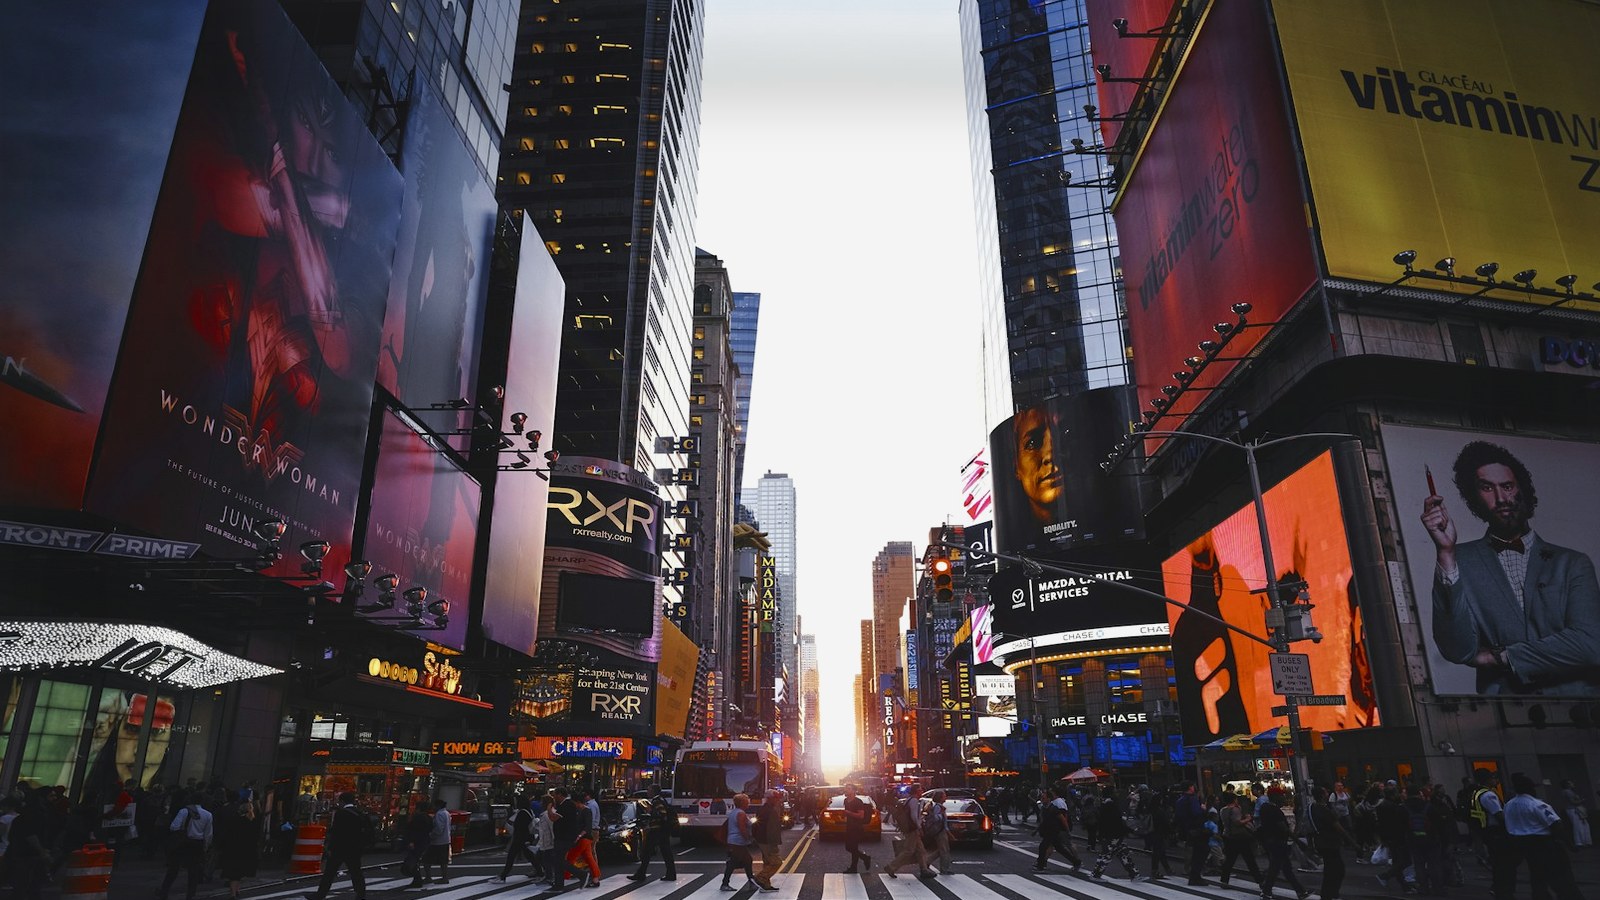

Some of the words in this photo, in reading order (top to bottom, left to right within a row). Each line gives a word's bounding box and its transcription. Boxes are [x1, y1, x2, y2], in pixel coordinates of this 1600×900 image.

[1139, 111, 1249, 311] vitaminwater
[1207, 159, 1259, 260] zero
[160, 388, 266, 464] WONDER
[276, 456, 341, 506] WOMAN
[167, 458, 183, 473] THE
[188, 470, 217, 489] FUTURE
[221, 486, 232, 495] OF
[234, 492, 263, 510] JUSTICE
[266, 506, 290, 523] BEGINS
[293, 520, 308, 532] WITH
[219, 505, 256, 533] JUN
[547, 486, 655, 541] RXR
[572, 527, 633, 543] rxrrealty.com
[1043, 519, 1078, 535] EQUALITY.
[109, 537, 188, 559] PRIME
[375, 522, 427, 563] WONDER
[432, 555, 468, 583] WOMAN
[545, 555, 586, 565] SHARP
[761, 557, 776, 621] MADAME
[1038, 577, 1076, 592] MAZDA
[1039, 586, 1089, 603] SERVICES
[1062, 631, 1094, 642] CHASE
[1140, 624, 1170, 635] CHAS
[100, 637, 205, 682] LOFT
[1278, 656, 1302, 665] BUSES
[617, 669, 635, 680] New
[635, 672, 648, 682] York
[1282, 665, 1300, 673] ONLY
[577, 678, 592, 688] for
[594, 680, 609, 690] the
[609, 681, 625, 691] 21st
[626, 682, 650, 695] Century
[959, 661, 970, 698] VICTORY
[590, 692, 642, 715] RXR
[1308, 696, 1344, 705] Broadway
[601, 712, 634, 721] REALTY
[885, 696, 895, 745] REGAL
[1051, 716, 1086, 728] CHASE
[1101, 713, 1148, 725] CHASE
[443, 742, 480, 755] KNOW
[551, 741, 624, 756] CHAMPS
